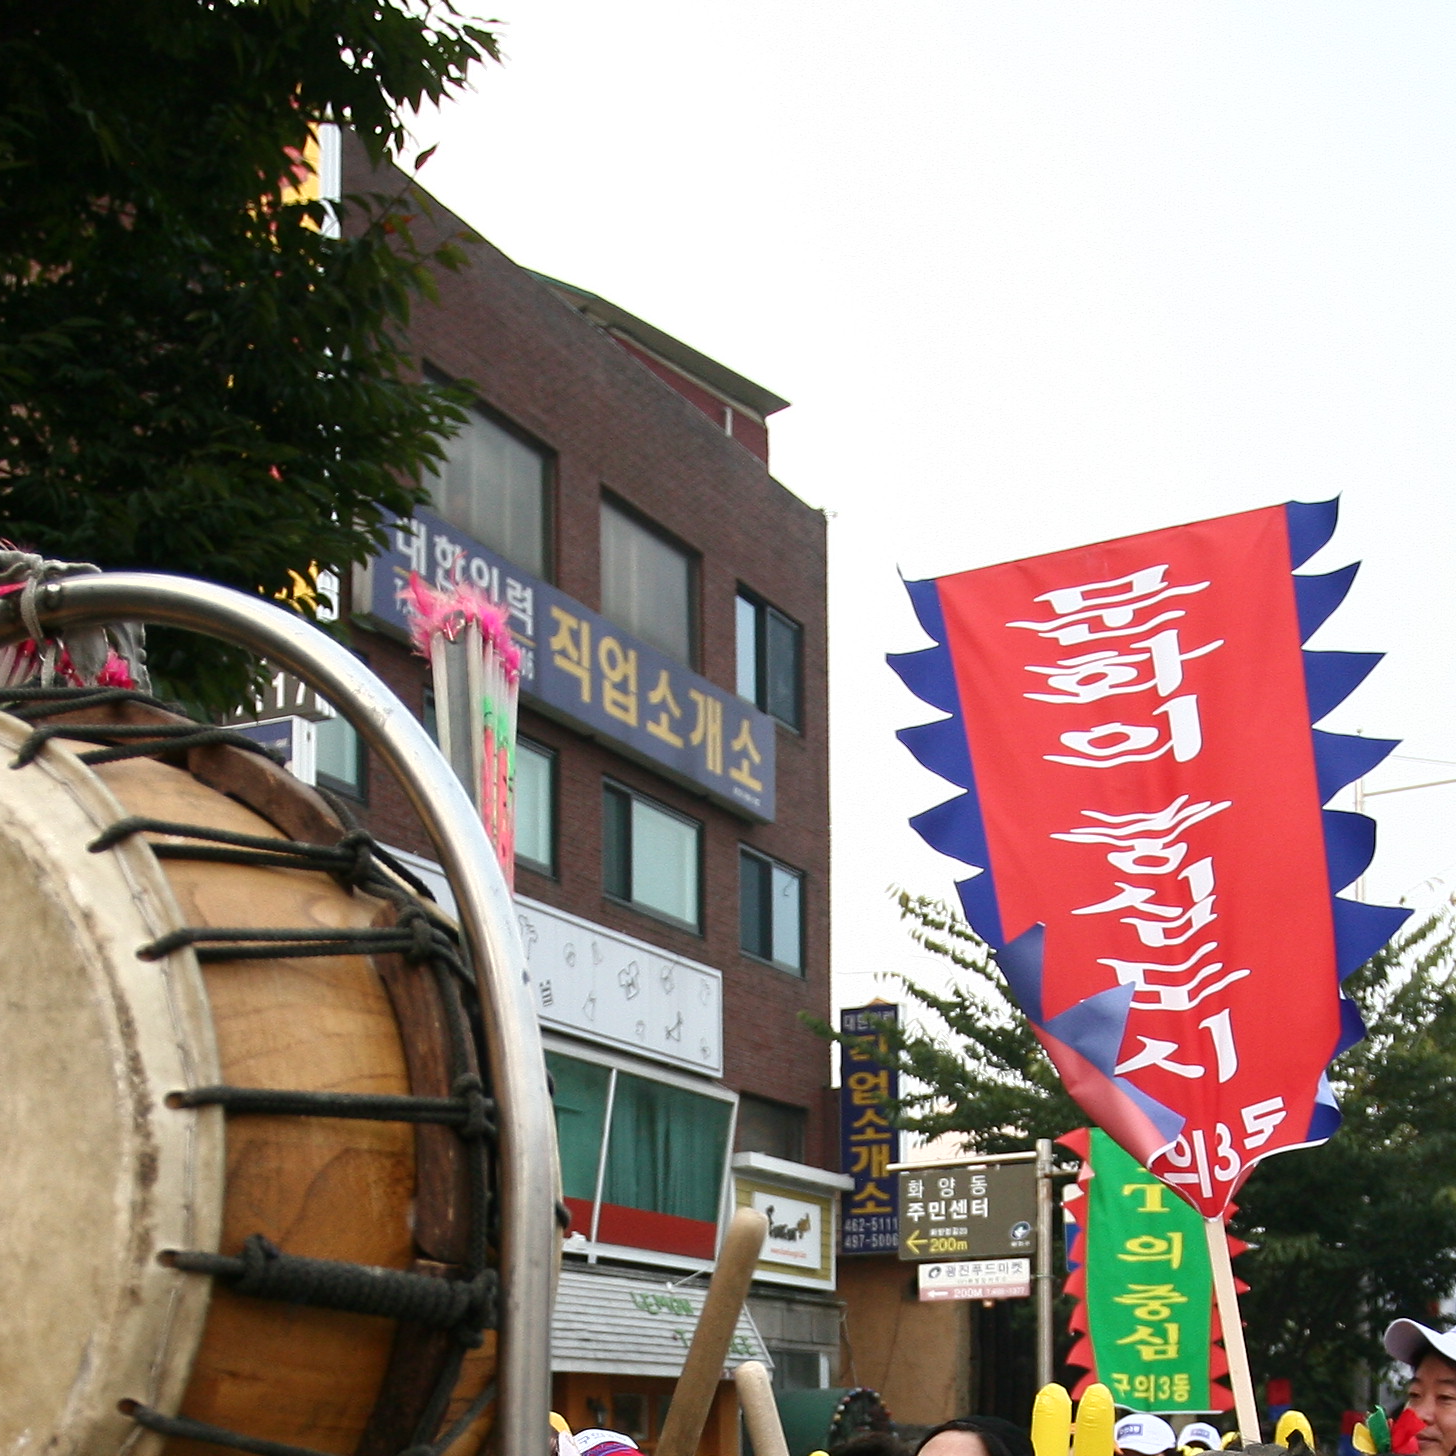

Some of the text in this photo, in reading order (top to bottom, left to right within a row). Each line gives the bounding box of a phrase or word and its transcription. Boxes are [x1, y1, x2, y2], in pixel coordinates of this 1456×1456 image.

[549, 606, 763, 792] 직업소개소
[1005, 563, 1251, 1083] 문화의 중심도시
[906, 1198, 989, 1222] 주민센터
[846, 1217, 898, 1232] 462-5111
[846, 1233, 899, 1249] 497-5006
[929, 1237, 968, 1253] 200m
[953, 1287, 984, 1298] 200M
[1111, 1373, 1191, 1403] 구의3동
